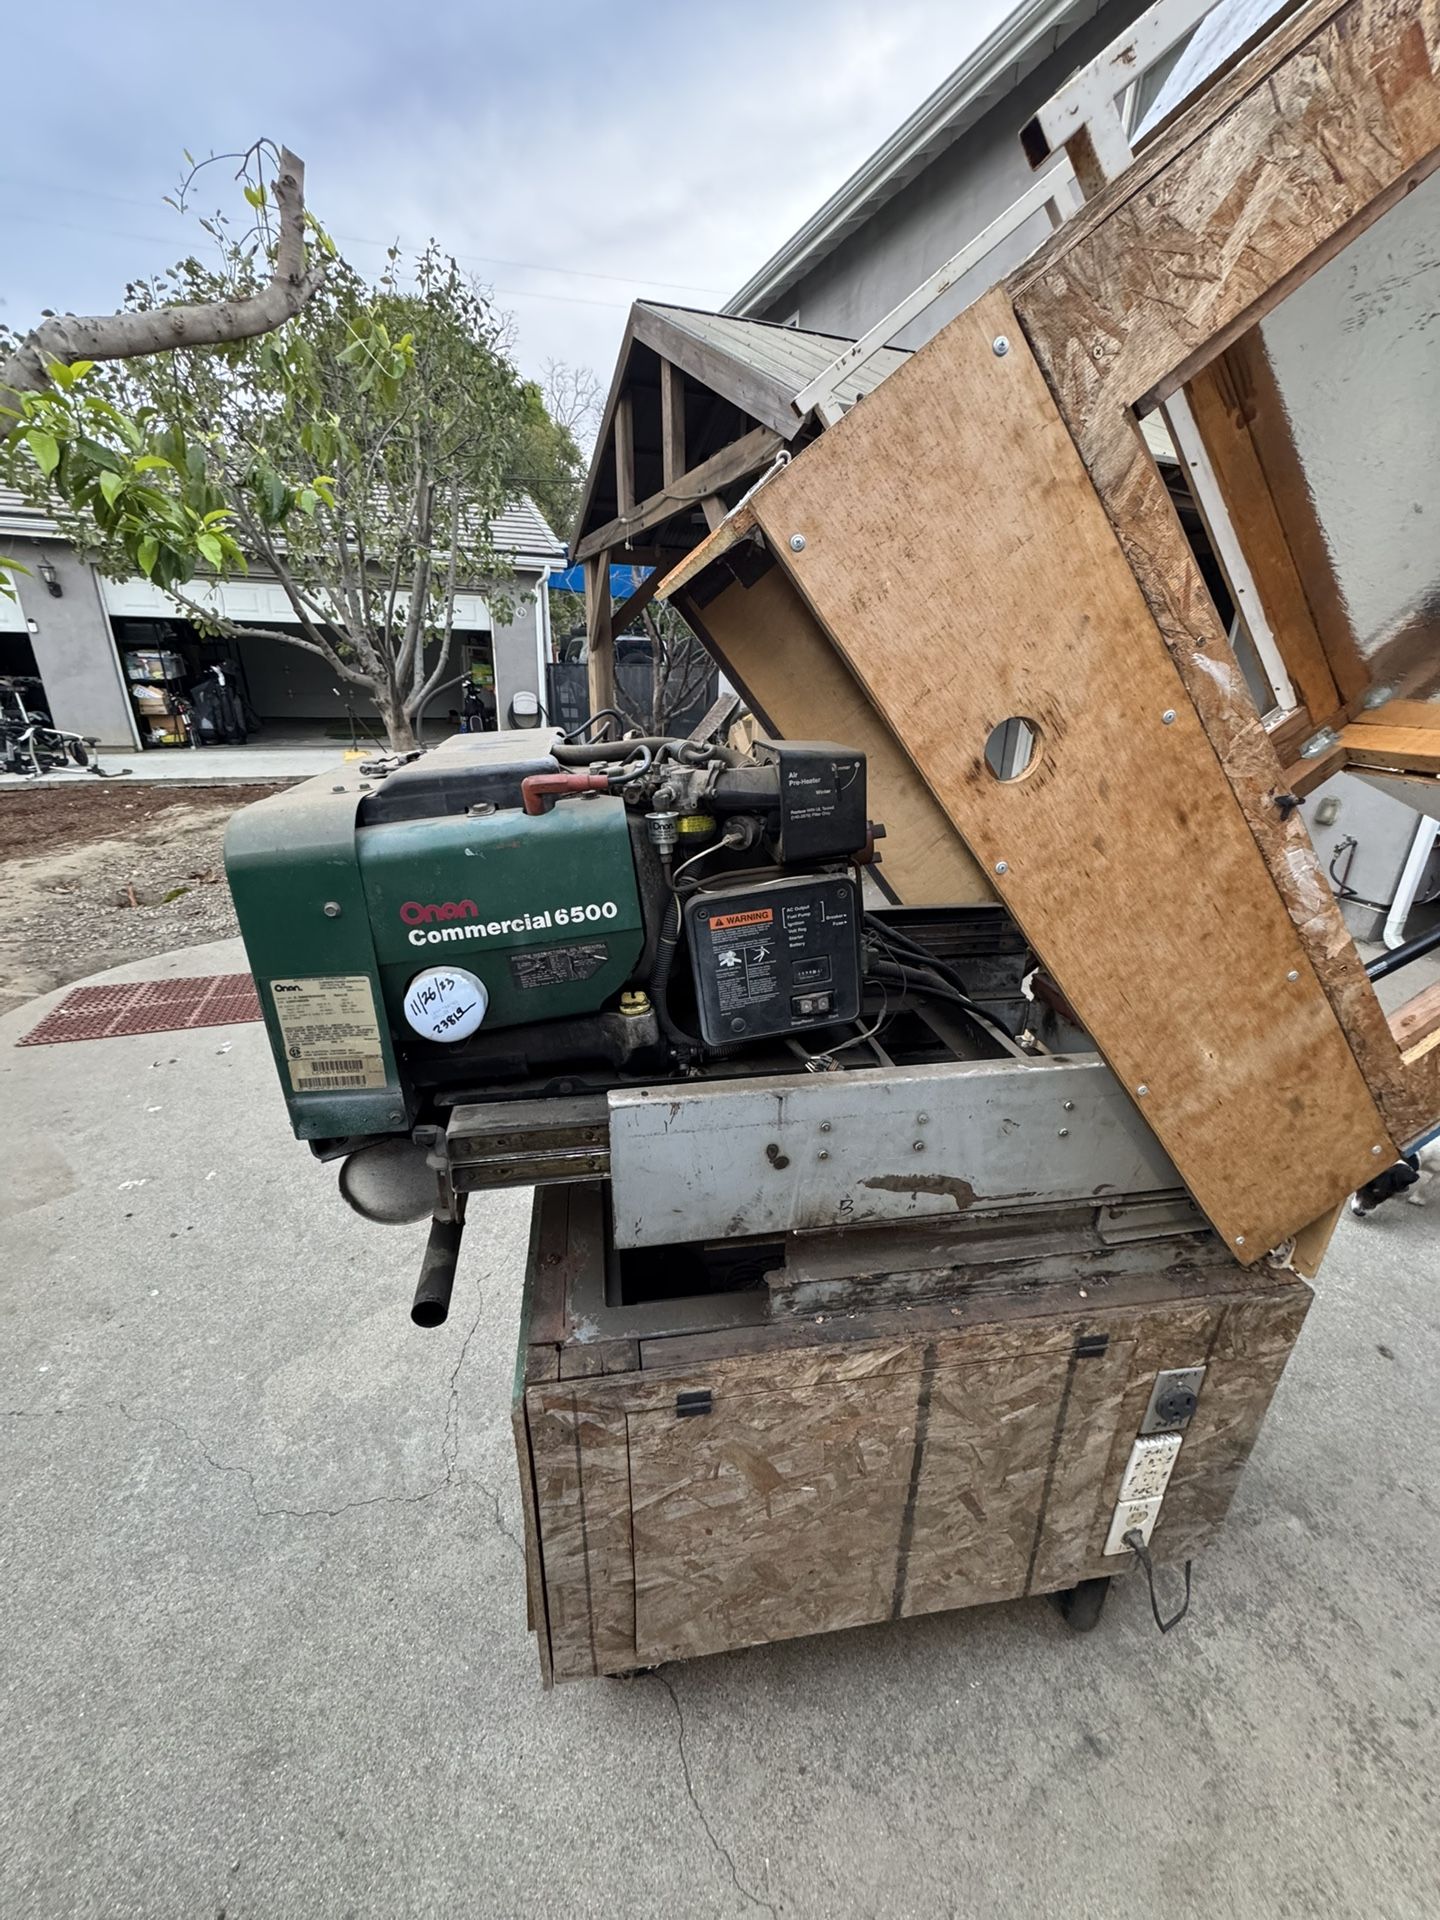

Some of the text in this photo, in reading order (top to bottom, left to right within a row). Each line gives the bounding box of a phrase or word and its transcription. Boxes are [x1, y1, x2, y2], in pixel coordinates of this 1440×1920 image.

[788, 771, 799, 779] Air
[788, 777, 823, 787] Pre-Heater
[400, 899, 479, 925] Onan
[726, 911, 769, 924] WARNING
[408, 901, 618, 946] Commercial 6500
